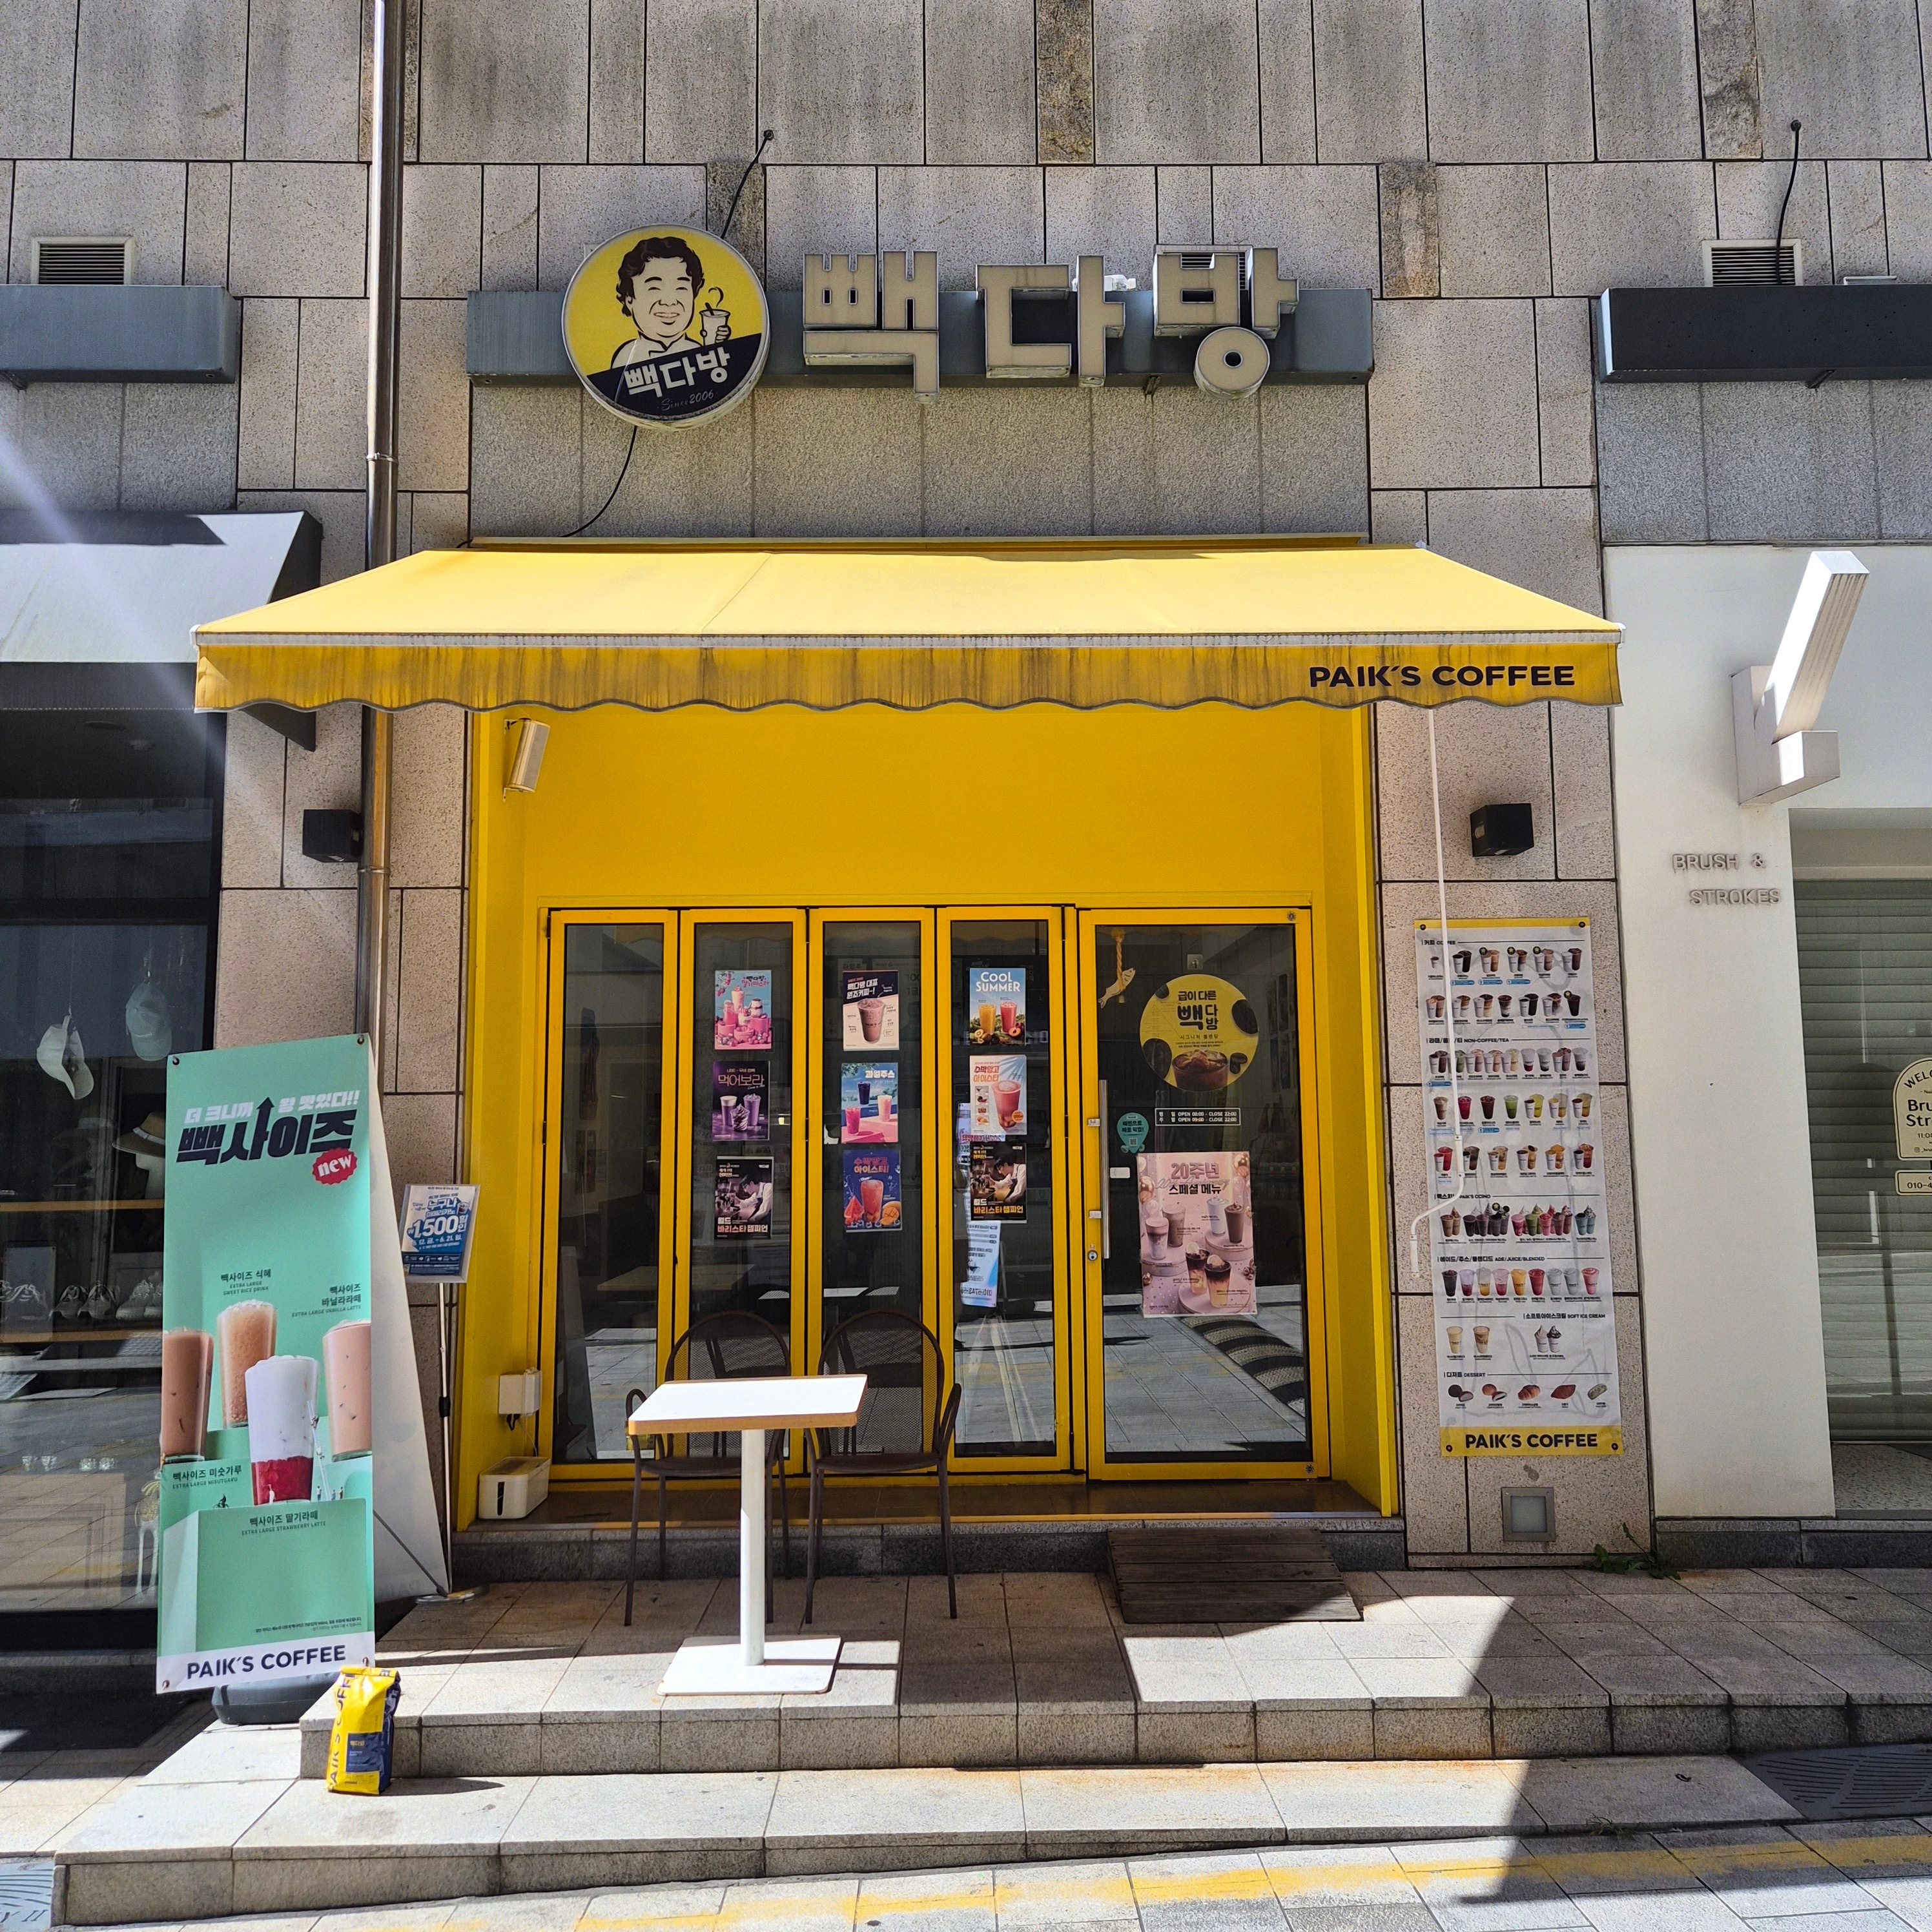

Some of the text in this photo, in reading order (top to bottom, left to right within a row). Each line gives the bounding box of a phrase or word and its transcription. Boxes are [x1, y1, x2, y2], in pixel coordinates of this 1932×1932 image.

[803, 244, 1299, 405] 빽다방
[624, 346, 731, 398] 빽다방
[1309, 665, 1575, 688] PAIK'S COFFEE
[1672, 852, 1767, 870] BRUSH &
[1690, 889, 1781, 905] STROKES
[981, 972, 1012, 982] COOL
[847, 981, 865, 991] 빽다방
[976, 981, 1021, 992] SUMMER
[1178, 991, 1217, 1001] 급이 다른
[718, 1074, 765, 1086] 먹어보라
[973, 1074, 999, 1082] 아이스티
[185, 1107, 202, 1124] 더
[205, 1102, 254, 1122] 크니까
[176, 1097, 357, 1166] 빽사이즈
[317, 1154, 353, 1177] new
[1171, 1162, 1220, 1180] 20주년
[1169, 1184, 1222, 1195] 스페셜 메뉴
[427, 1197, 457, 1210] 누구나
[221, 1271, 252, 1282] 빽사이즈
[329, 1284, 361, 1295] 빽사이즈
[322, 1294, 362, 1306] 바닐라라떼
[1465, 1434, 1598, 1448] PAIK'S COFFEE
[172, 1465, 242, 1481] 빽사이즈 미숫가루
[208, 1477, 238, 1485] MISUTGARU
[250, 1510, 318, 1526] 빽사이즈 딸기라떼
[276, 1523, 310, 1532] STRAWBERRY
[187, 1645, 346, 1680] PAIK'S COFFEE
